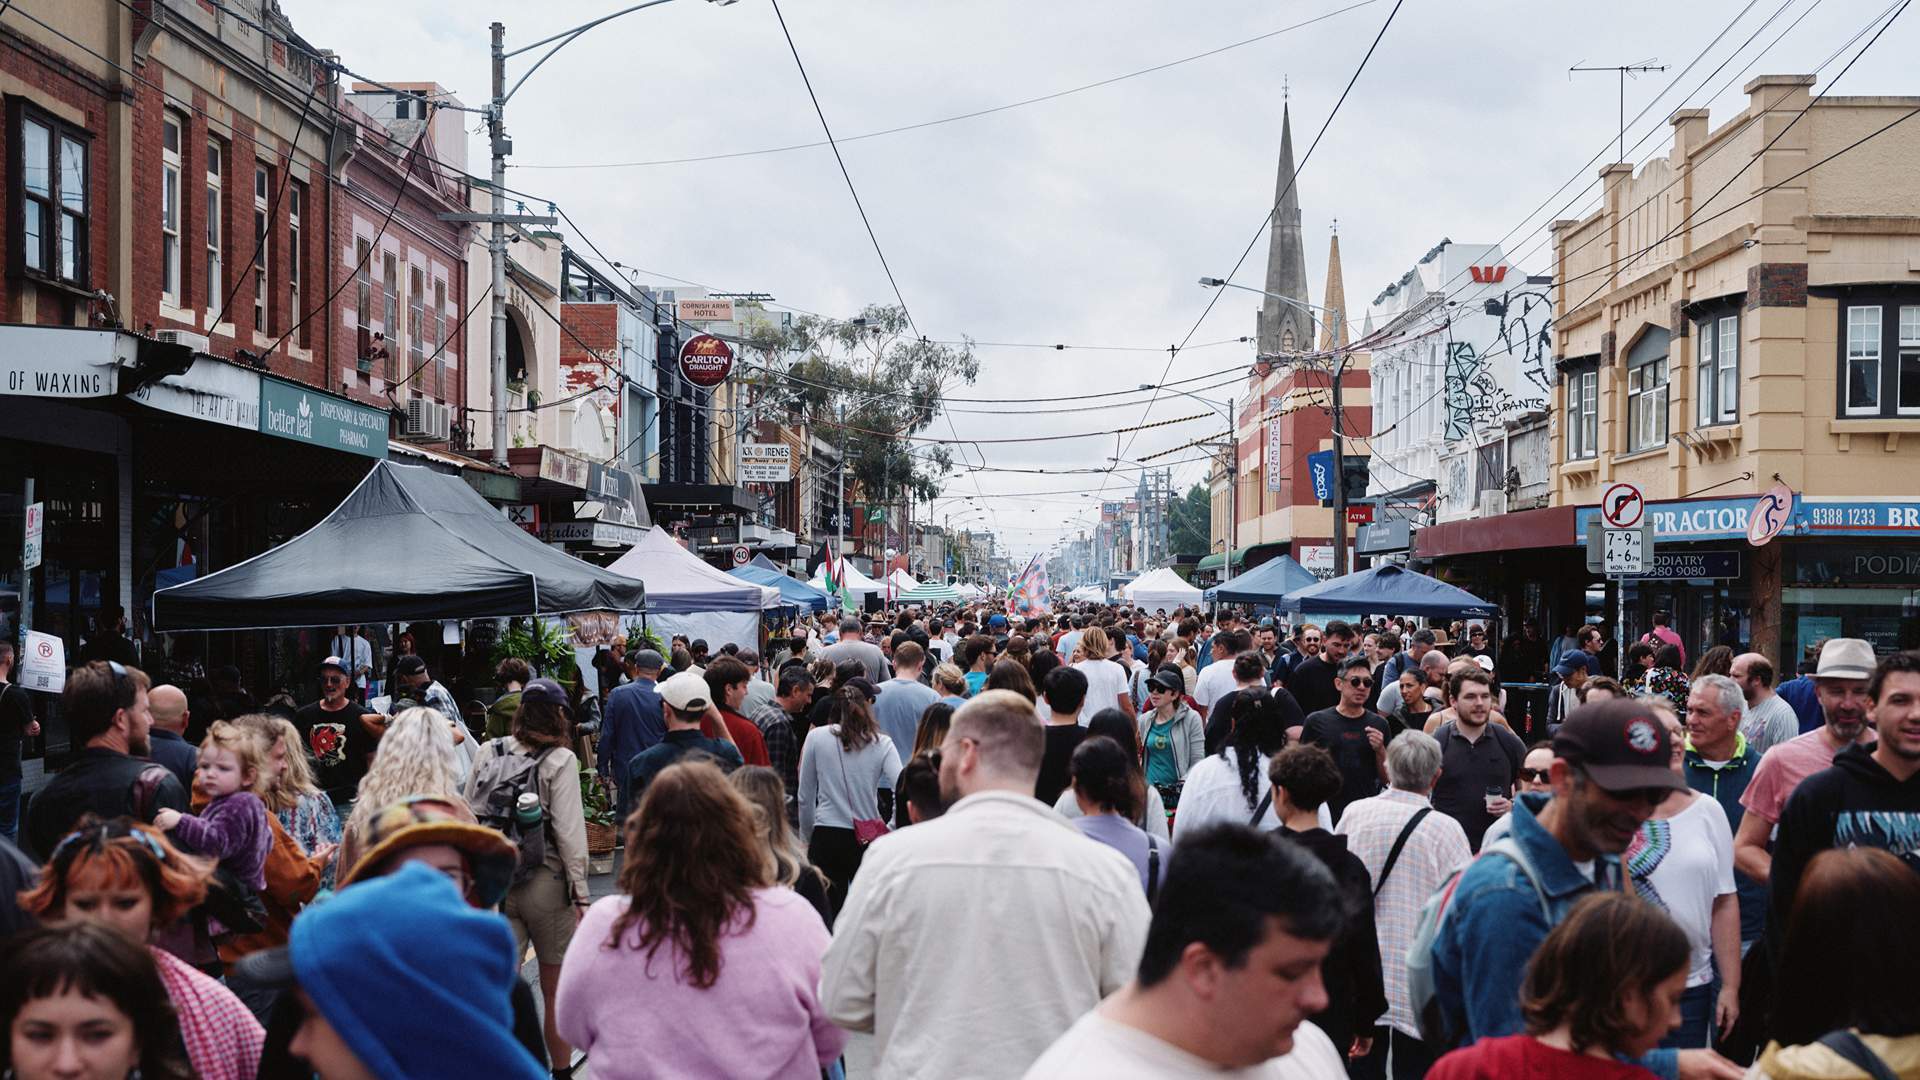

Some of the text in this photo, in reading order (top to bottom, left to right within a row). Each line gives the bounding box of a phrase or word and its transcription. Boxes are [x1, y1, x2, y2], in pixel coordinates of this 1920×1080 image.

[684, 355, 728, 365] CARLTON
[9, 370, 101, 394] OF WAXING
[268, 400, 314, 439] better leaf
[320, 401, 353, 423] DISPENSARY
[358, 411, 386, 432] SPECIALTY
[339, 428, 369, 449] PHARMACY
[765, 448, 789, 457] IRENES
[1653, 508, 1747, 532] PRACTOR
[1813, 508, 1843, 525] 9388
[1848, 508, 1876, 525] 1233
[736, 551, 747, 560] 40
[1653, 555, 1704, 566] ODIATRY
[1676, 566, 1706, 576] 9080
